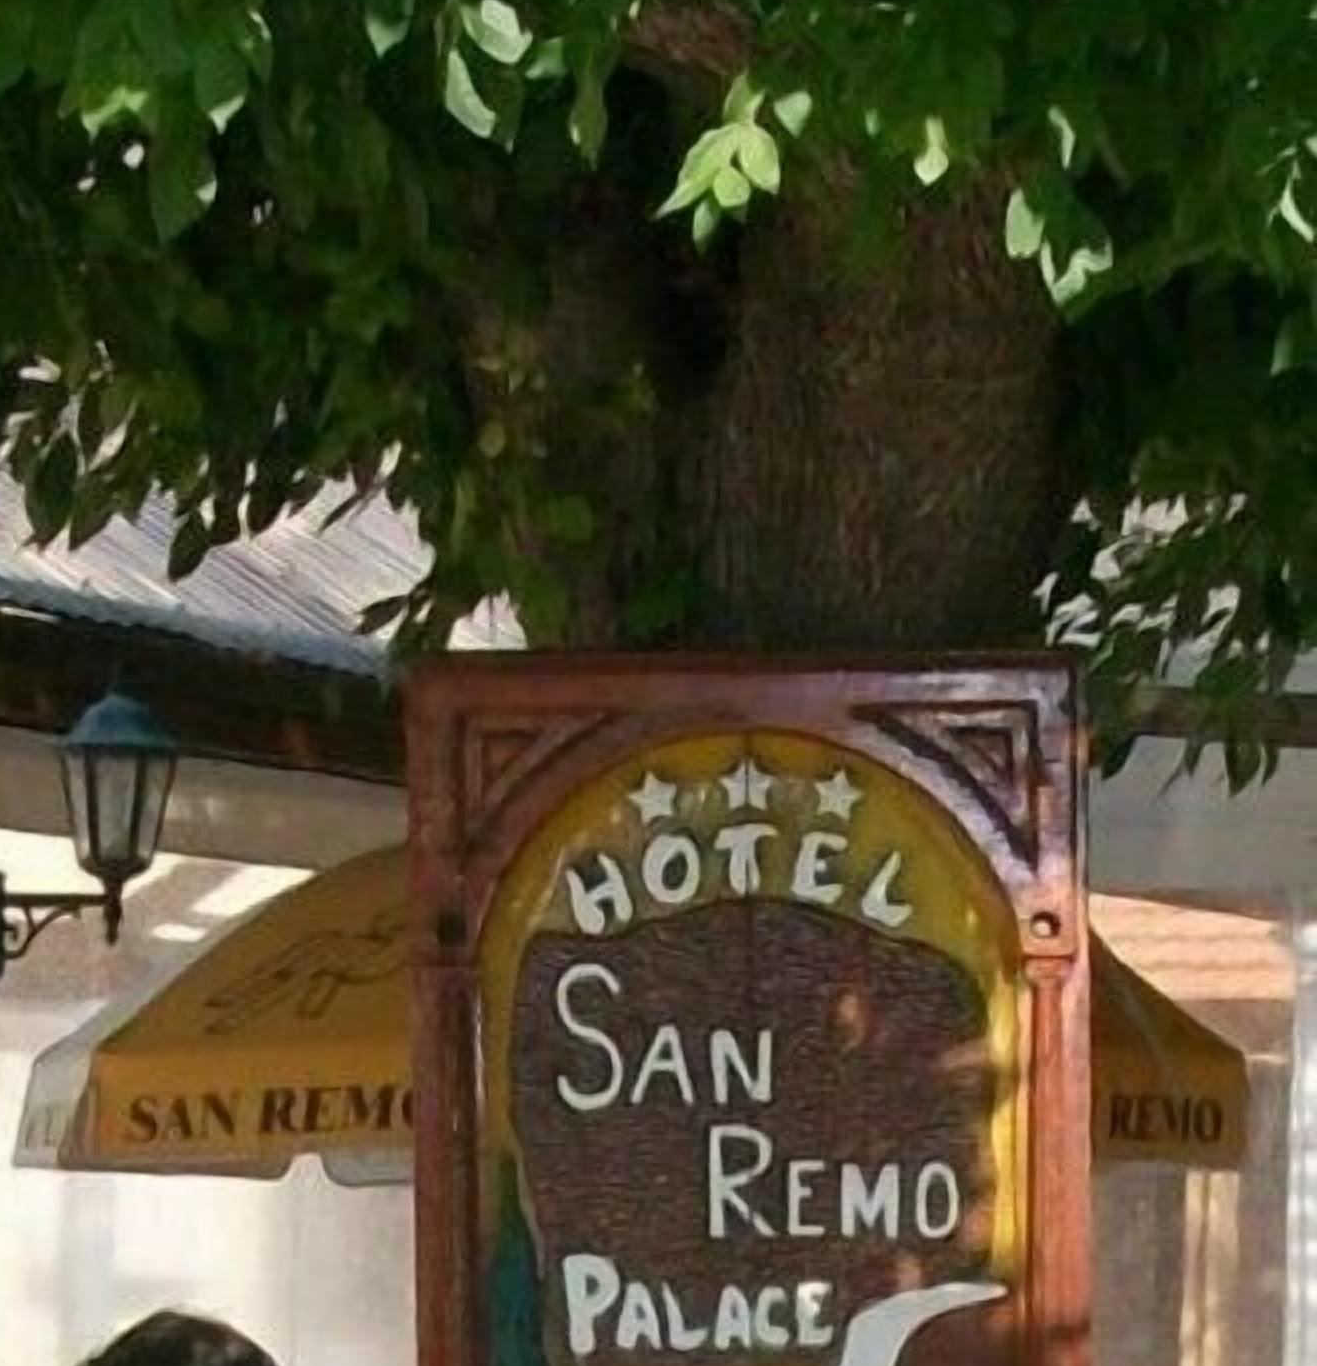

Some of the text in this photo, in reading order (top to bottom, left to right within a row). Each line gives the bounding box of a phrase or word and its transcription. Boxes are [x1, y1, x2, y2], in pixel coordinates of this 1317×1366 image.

[566, 823, 914, 935] HOTEL
[557, 963, 773, 1110] SAN
[128, 1089, 238, 1143] SAN
[1109, 1093, 1223, 1144] REMO
[709, 1123, 959, 1239] REMO
[563, 1253, 833, 1355] PALACE
